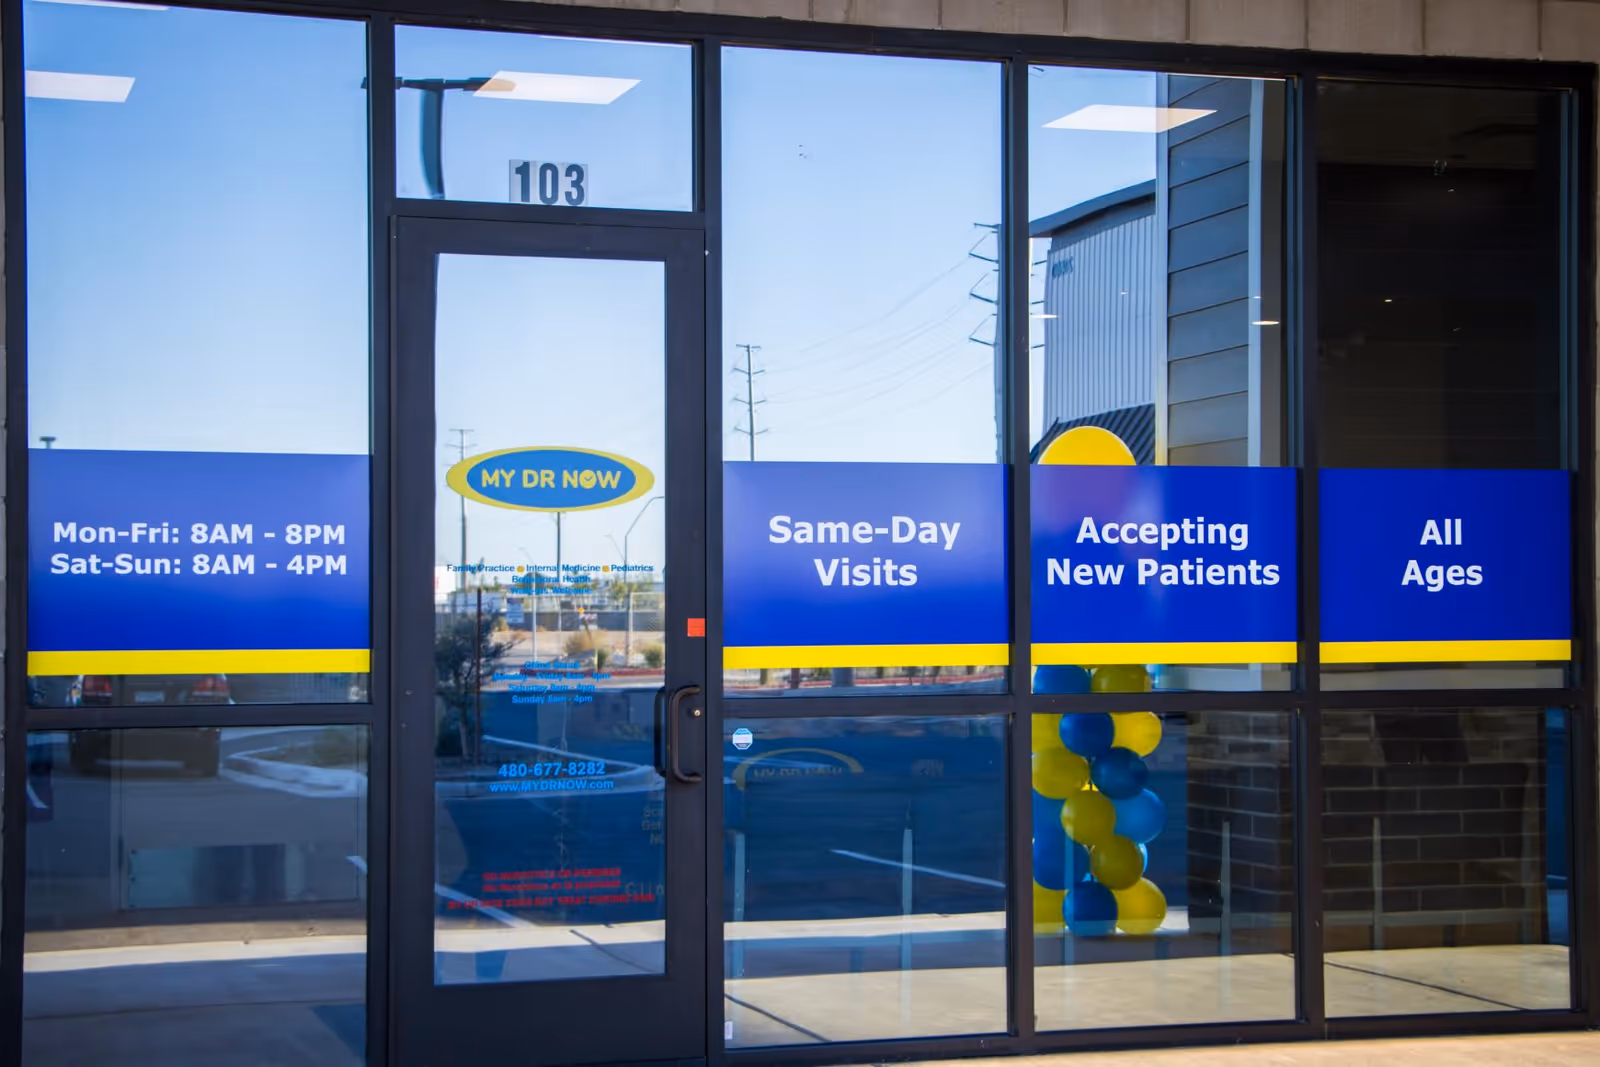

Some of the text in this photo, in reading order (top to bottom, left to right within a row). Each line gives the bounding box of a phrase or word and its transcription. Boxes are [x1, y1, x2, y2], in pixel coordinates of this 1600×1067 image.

[515, 161, 585, 206] 103
[481, 469, 621, 489] MY DR NOW
[53, 521, 180, 544] Mon-Fri:
[190, 522, 253, 544] 8AM
[285, 524, 346, 545] 8PM
[769, 515, 961, 551] Same-Day
[1076, 516, 1249, 551] Accepting
[1420, 518, 1462, 546] All
[50, 553, 182, 575] Sat-Sun:
[192, 554, 255, 575] 8AM
[287, 555, 348, 576] 4PM
[478, 564, 515, 572] Practice
[526, 564, 559, 572] Internal
[562, 564, 600, 572] Medicine
[611, 564, 654, 572] Pediatrics
[814, 557, 918, 587] Visits
[1047, 557, 1280, 586] New Patients
[1401, 559, 1483, 592] Ages
[512, 695, 545, 704] Sunday
[573, 695, 593, 703] 4pm
[498, 761, 606, 777] 480-677-8282
[490, 779, 615, 792] www.MYDRNOW.com
